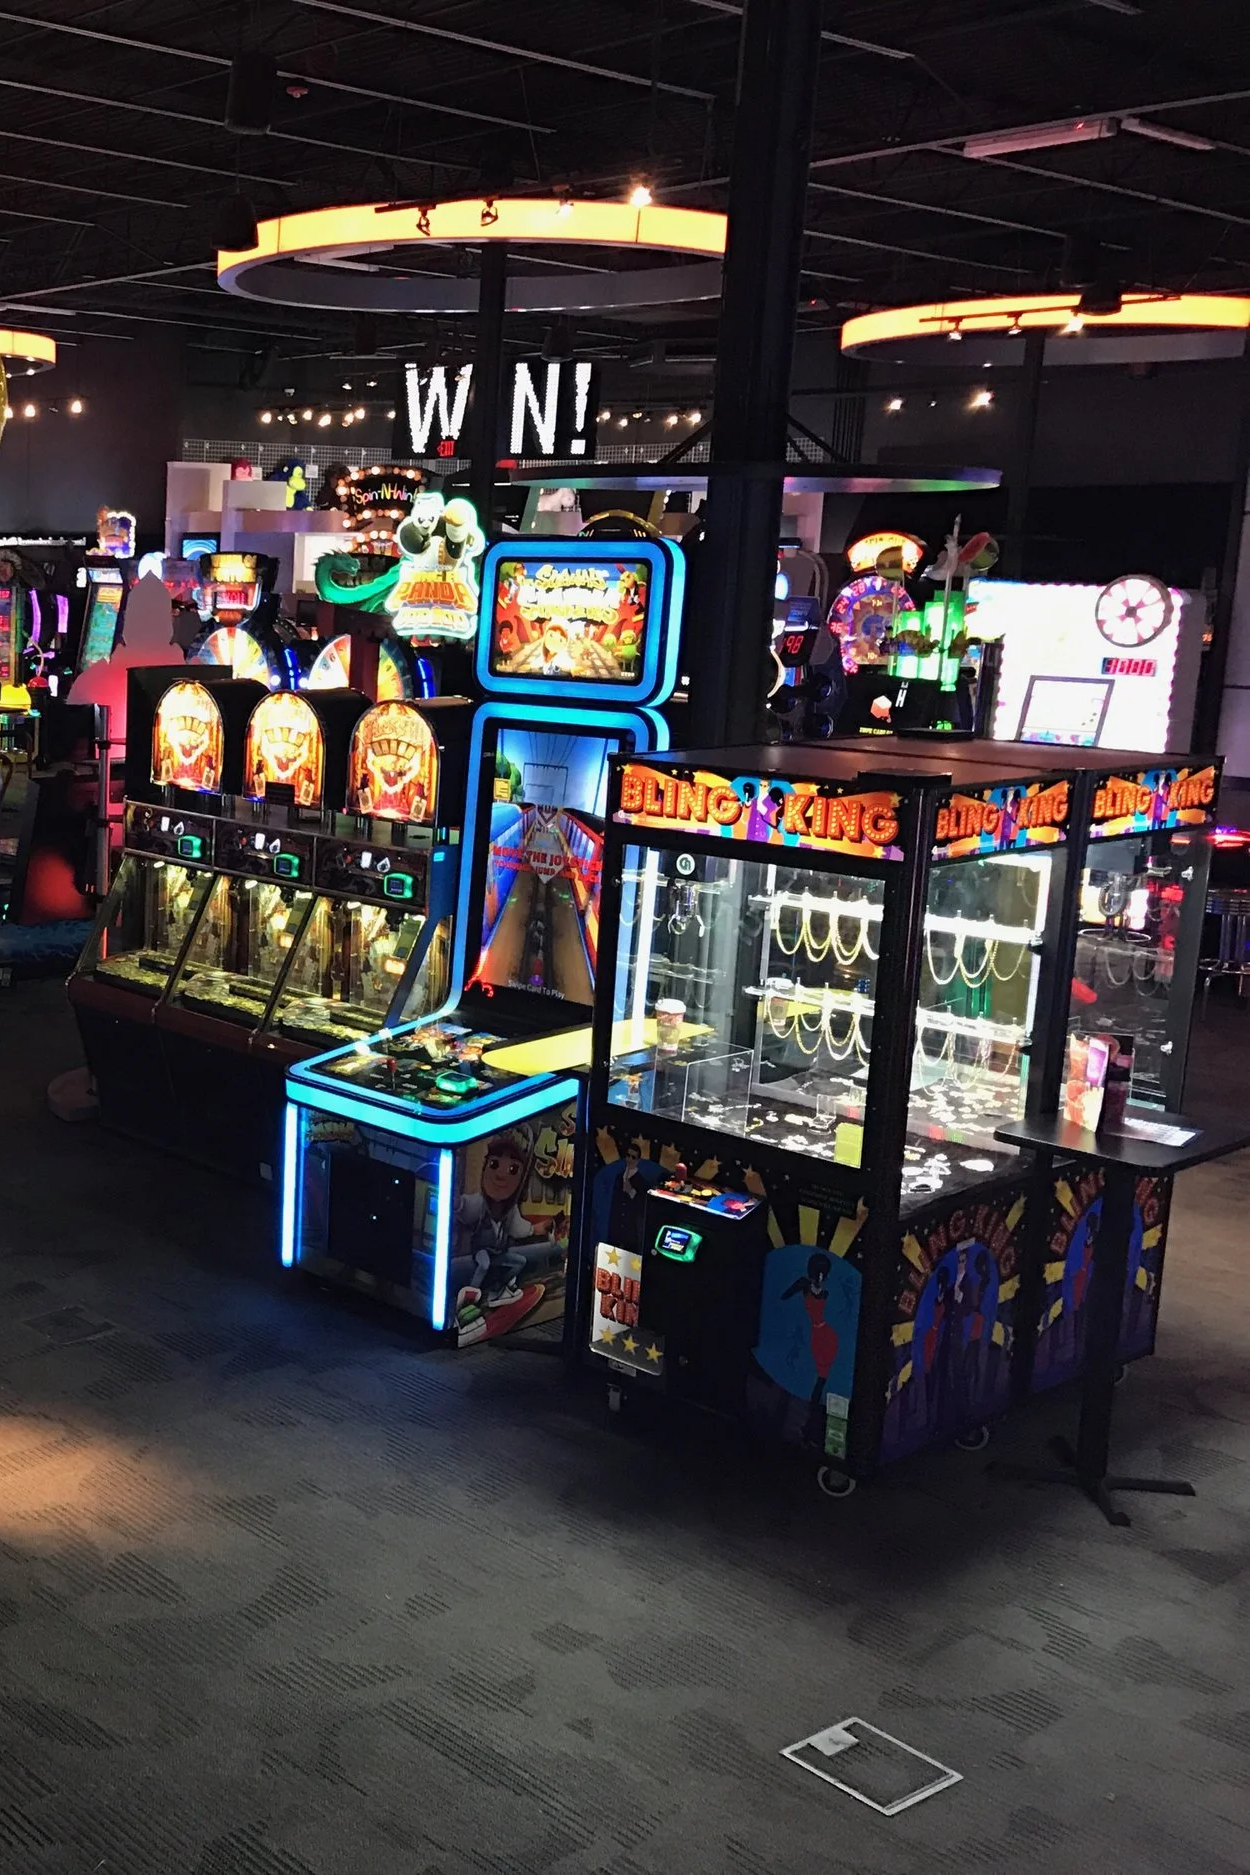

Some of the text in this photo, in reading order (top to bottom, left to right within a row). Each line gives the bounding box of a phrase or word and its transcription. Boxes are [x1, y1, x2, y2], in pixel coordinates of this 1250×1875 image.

[405, 363, 592, 455] WN!
[395, 581, 474, 609] PANDA
[620, 773, 899, 846] BLING KING
[935, 794, 1069, 840] BLING KING
[1093, 779, 1215, 818] BLING KING
[526, 850, 547, 863] THE
[508, 979, 566, 1000] Swipe Card To Play
[599, 1293, 639, 1328] KIN
